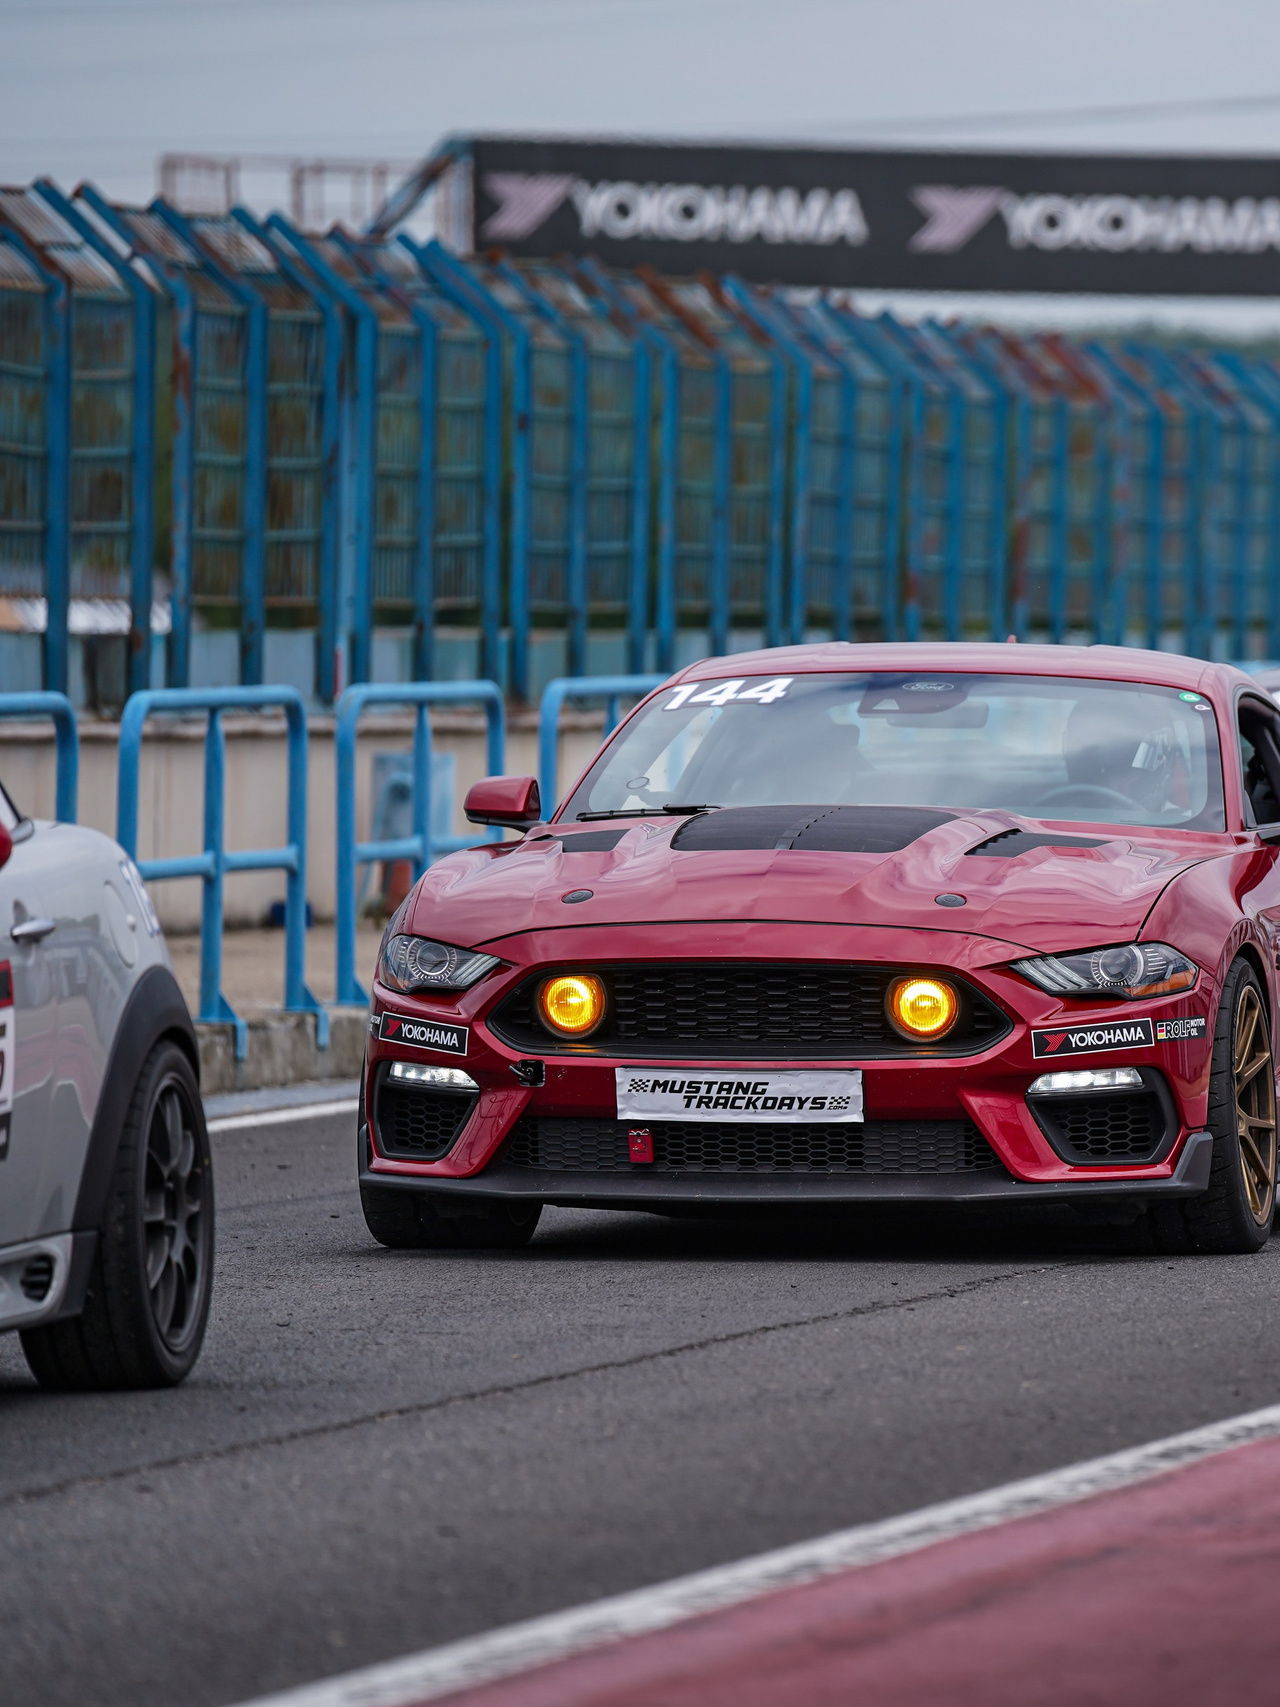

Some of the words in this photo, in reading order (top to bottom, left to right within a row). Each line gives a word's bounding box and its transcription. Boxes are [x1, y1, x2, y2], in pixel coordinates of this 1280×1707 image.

[573, 181, 869, 247] YOKOHAMA
[663, 677, 795, 711] 144
[1164, 1019, 1191, 1039] ROLF
[1190, 1018, 1206, 1027] MOTOR
[1190, 1028, 1199, 1036] OIL
[401, 1023, 459, 1047] YOKOHAMA
[1067, 1026, 1146, 1048] YOKOHAMA
[650, 1079, 770, 1096] MUSTANG
[682, 1095, 828, 1111] TRACKDAYS
